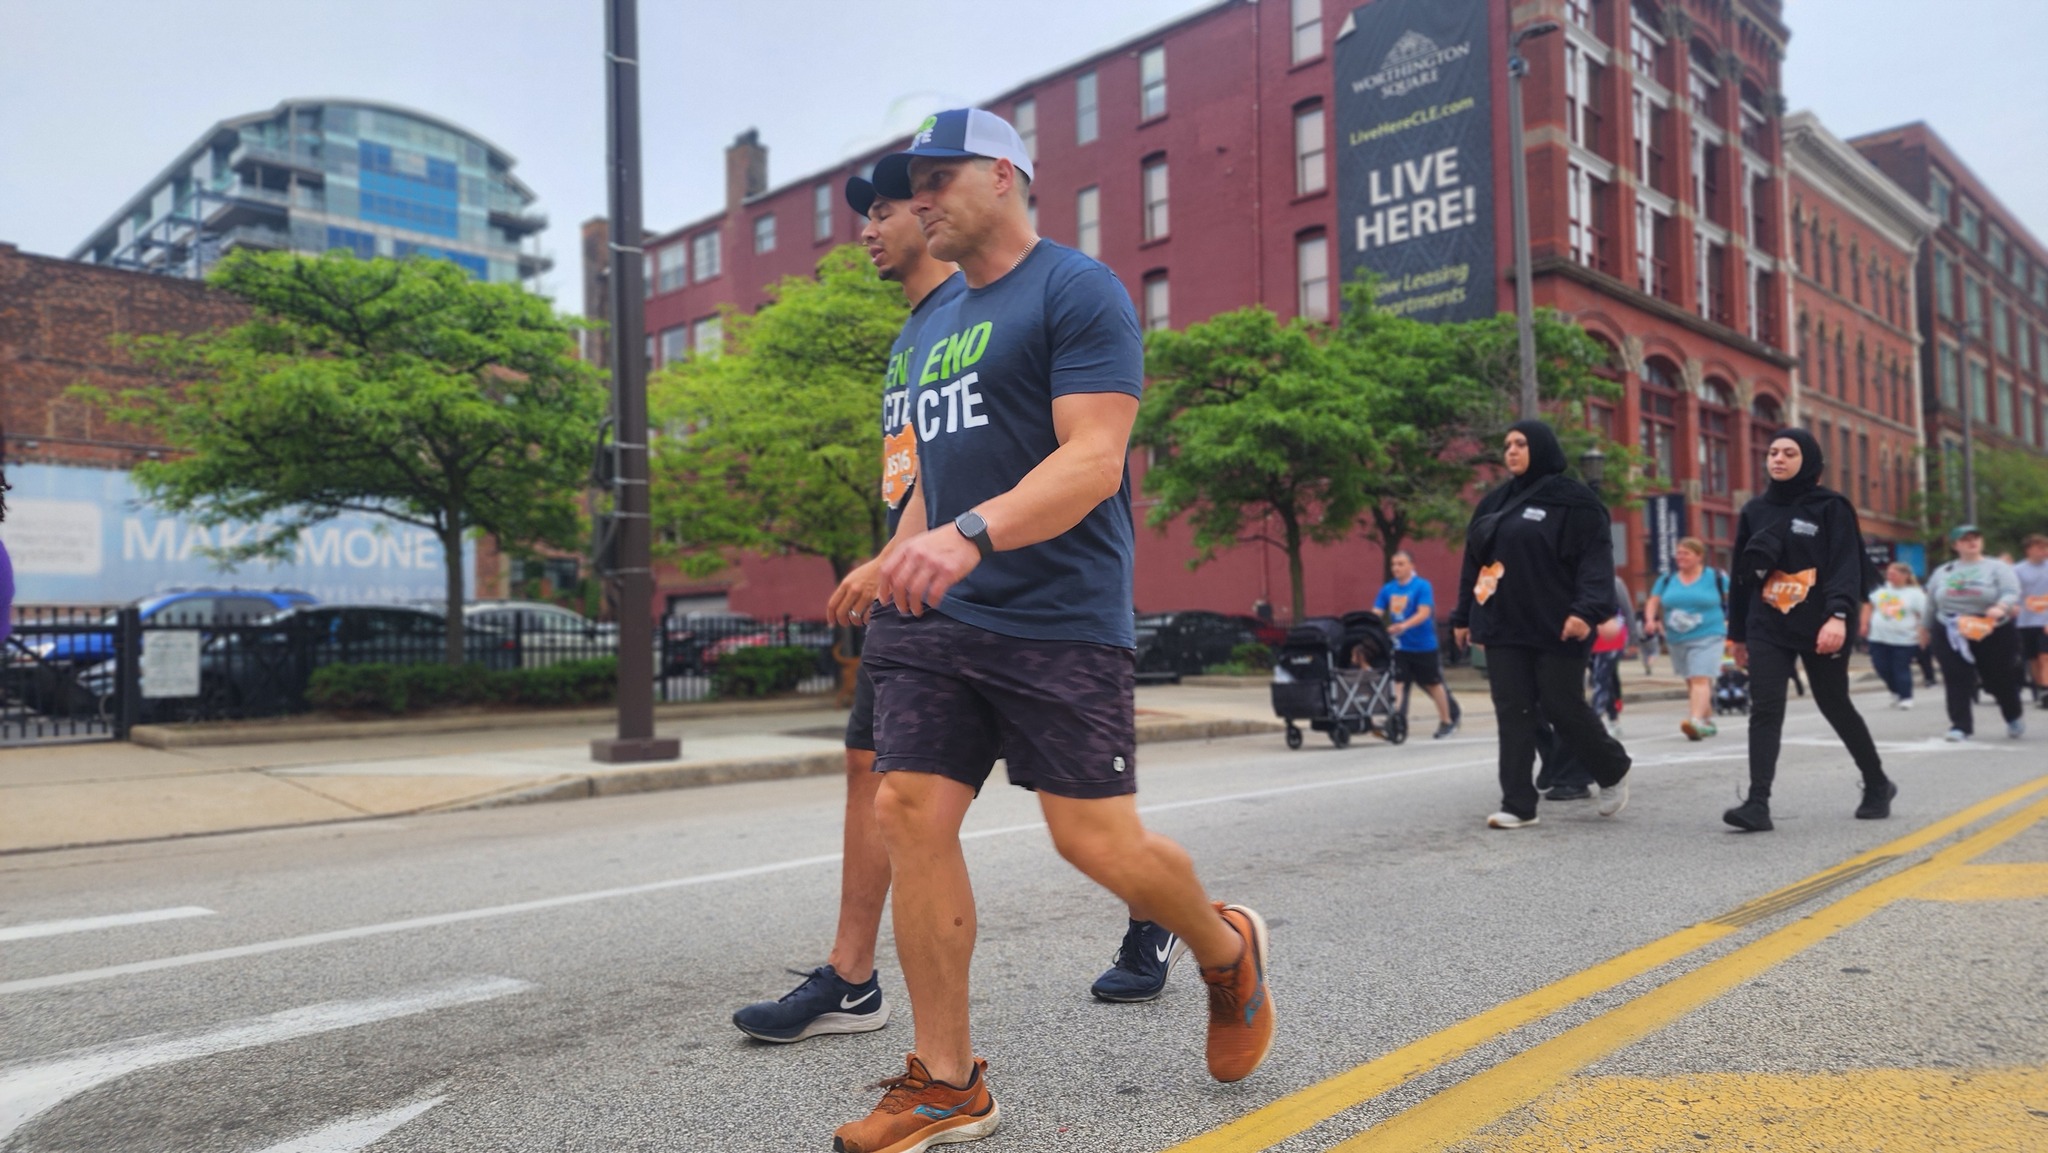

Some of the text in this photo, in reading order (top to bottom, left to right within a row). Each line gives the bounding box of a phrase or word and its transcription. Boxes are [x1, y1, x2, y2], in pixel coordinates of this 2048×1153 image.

[1352, 41, 1470, 93] WORTHINGTON
[1381, 68, 1439, 99] SQUARE
[1349, 96, 1474, 146] LiveHereCLE.com
[1369, 146, 1460, 206] LIVE
[1356, 186, 1476, 251] HERE!
[1403, 262, 1470, 291] Leasing
[885, 346, 914, 391] EN
[918, 321, 993, 387] END
[917, 371, 989, 443] CTE
[295, 526, 440, 569] MONE
